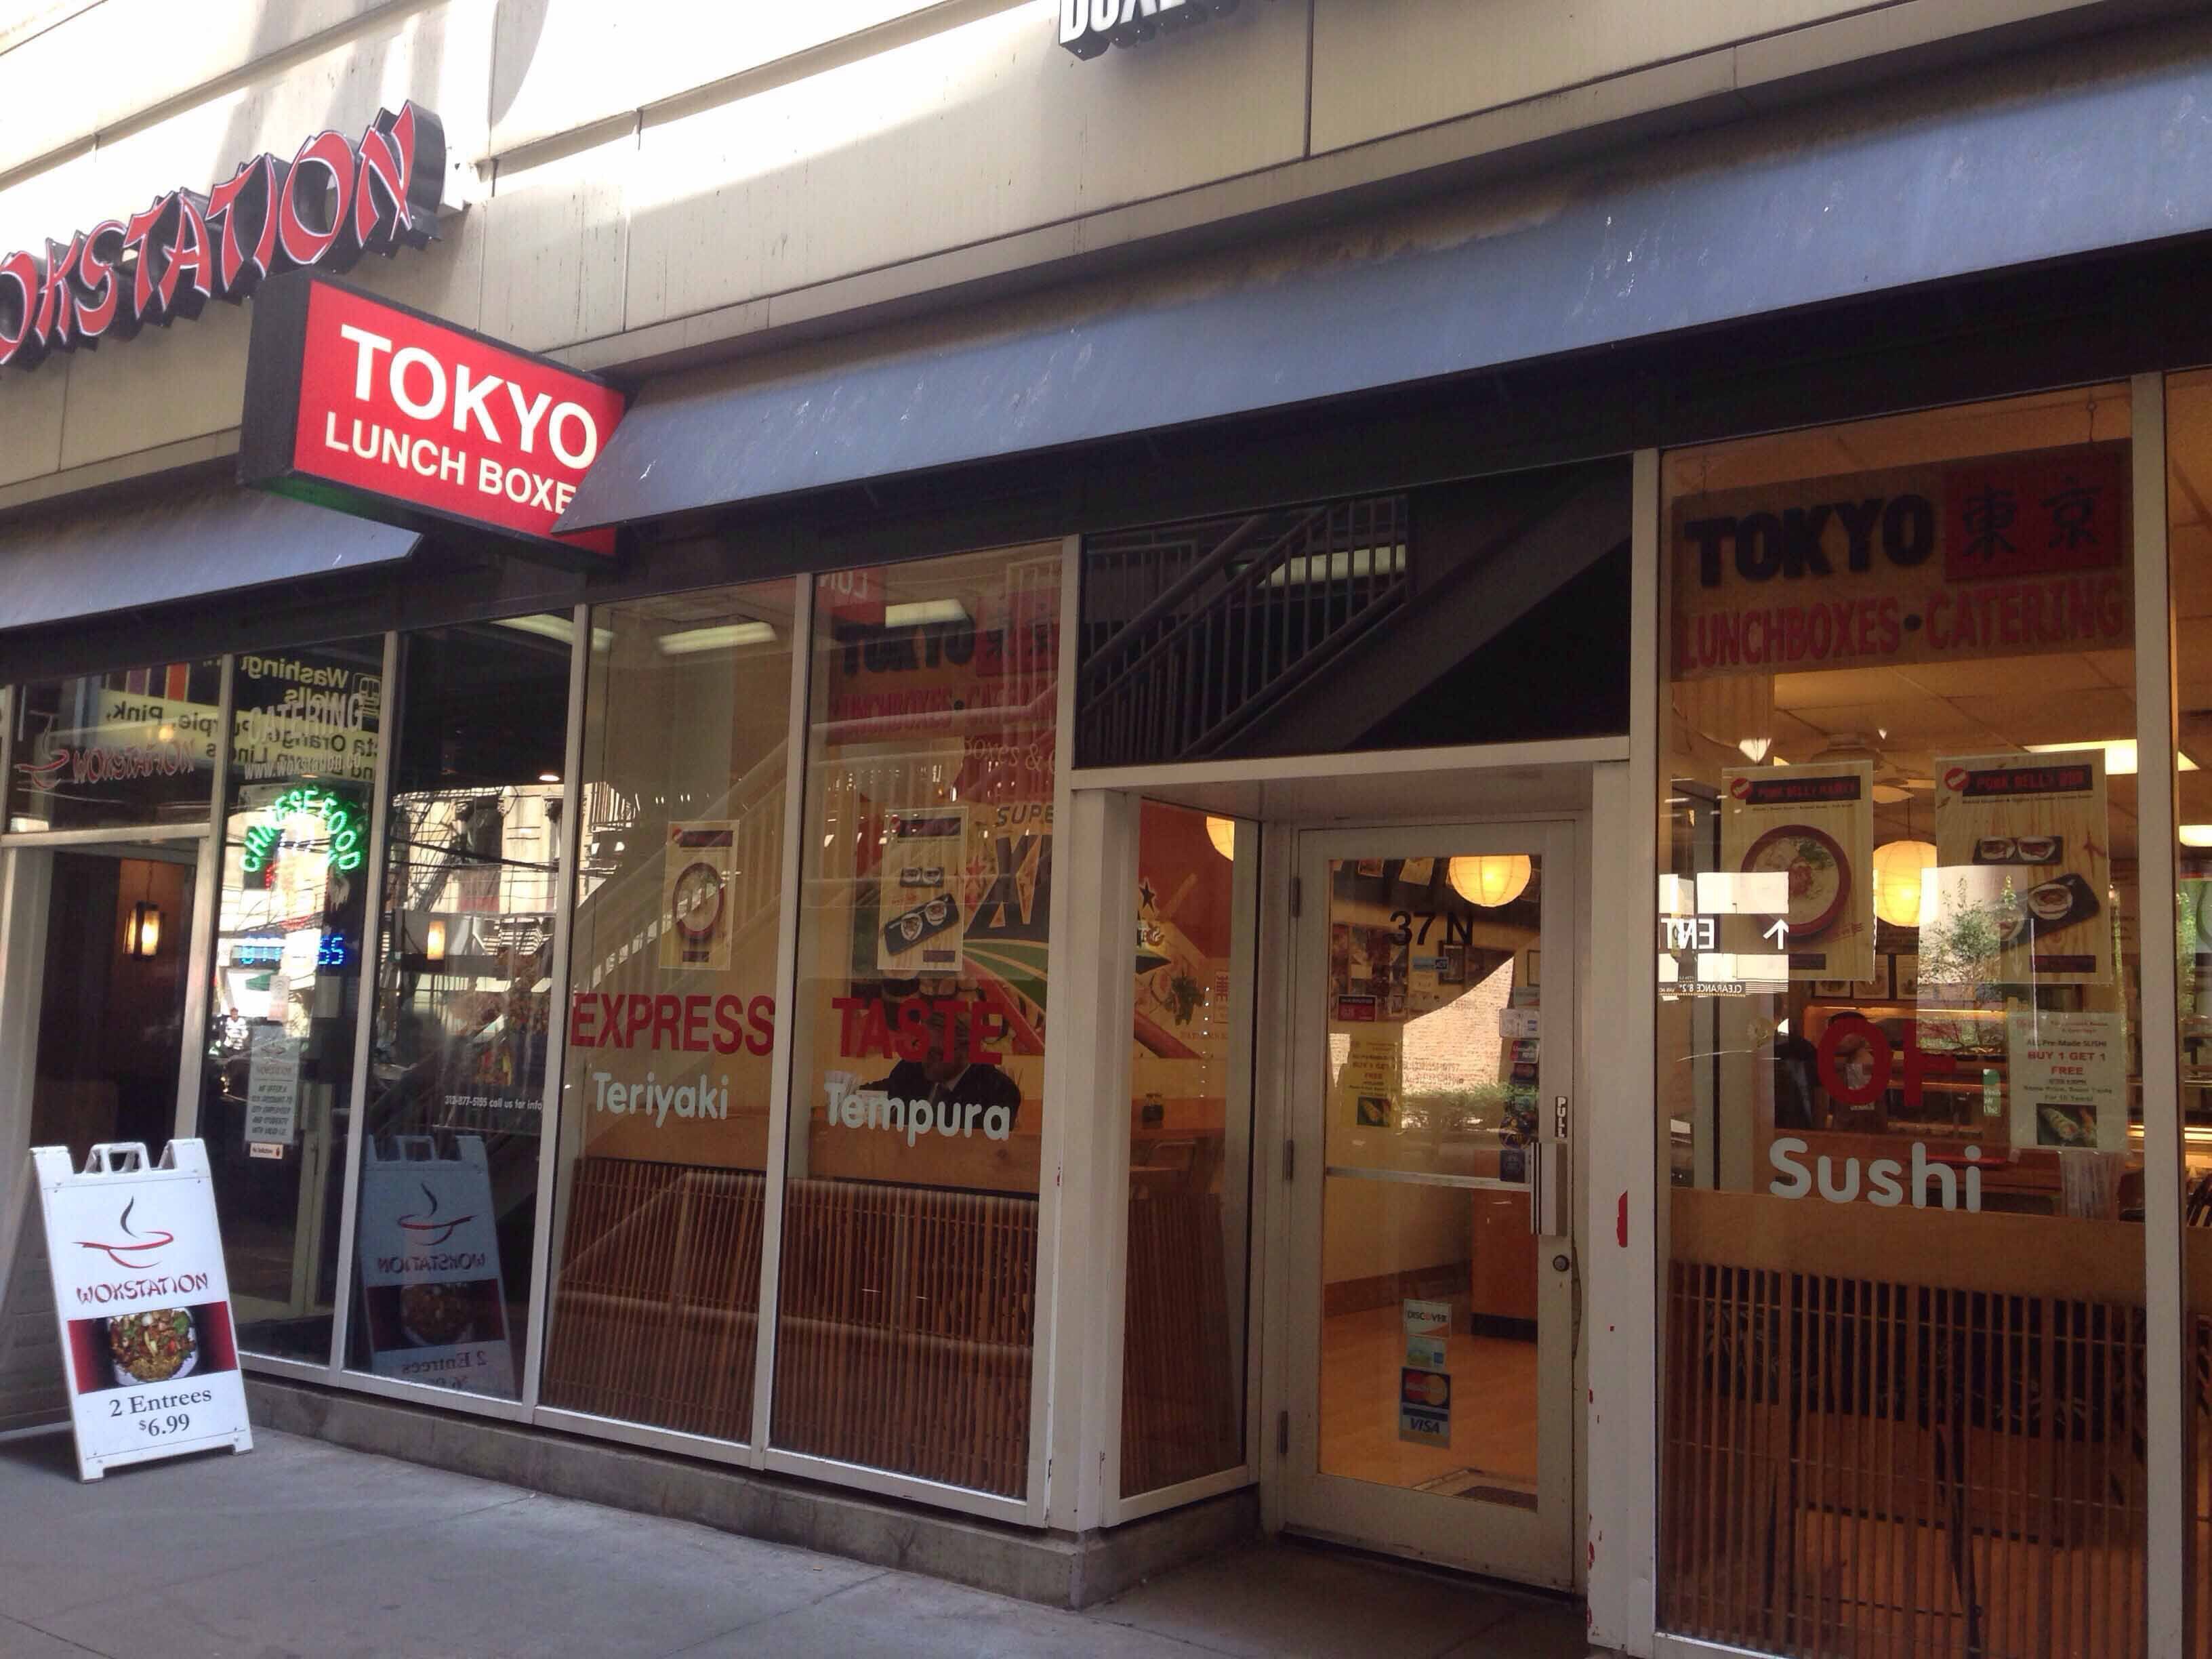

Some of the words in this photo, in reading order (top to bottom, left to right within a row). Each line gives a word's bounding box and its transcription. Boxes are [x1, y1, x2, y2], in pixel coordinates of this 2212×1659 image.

[341, 324, 598, 470] TOKYO
[325, 411, 466, 486] LUNCH
[1683, 493, 1935, 589] TOKYO
[1679, 595, 1902, 672] LUNCHBOXES
[1923, 573, 2125, 651] CATERING
[319, 797, 361, 870] FOOD
[1389, 910, 1437, 947] 37
[1446, 912, 1474, 945] N
[570, 993, 776, 1057] EXPRESS
[832, 996, 1004, 1065] TASTE
[2028, 1051, 2053, 1061] BUY
[2058, 1051, 2064, 1060] 1
[2069, 1052, 2095, 1061] GET
[2051, 1066, 2084, 1076] FREE
[489, 1097, 503, 1108] call
[504, 1101, 513, 1109] us
[592, 1071, 729, 1128] Teriyaki
[823, 1082, 1011, 1147] Tempura
[1556, 1096, 1567, 1139] PULL
[1769, 1136, 1983, 1214] Sushi
[76, 1272, 209, 1305] WOKSTATION
[108, 1398, 123, 1418] 2
[129, 1386, 212, 1415] Entrees
[138, 1412, 190, 1437] $6.99
[1410, 1416, 1441, 1435] VISA
